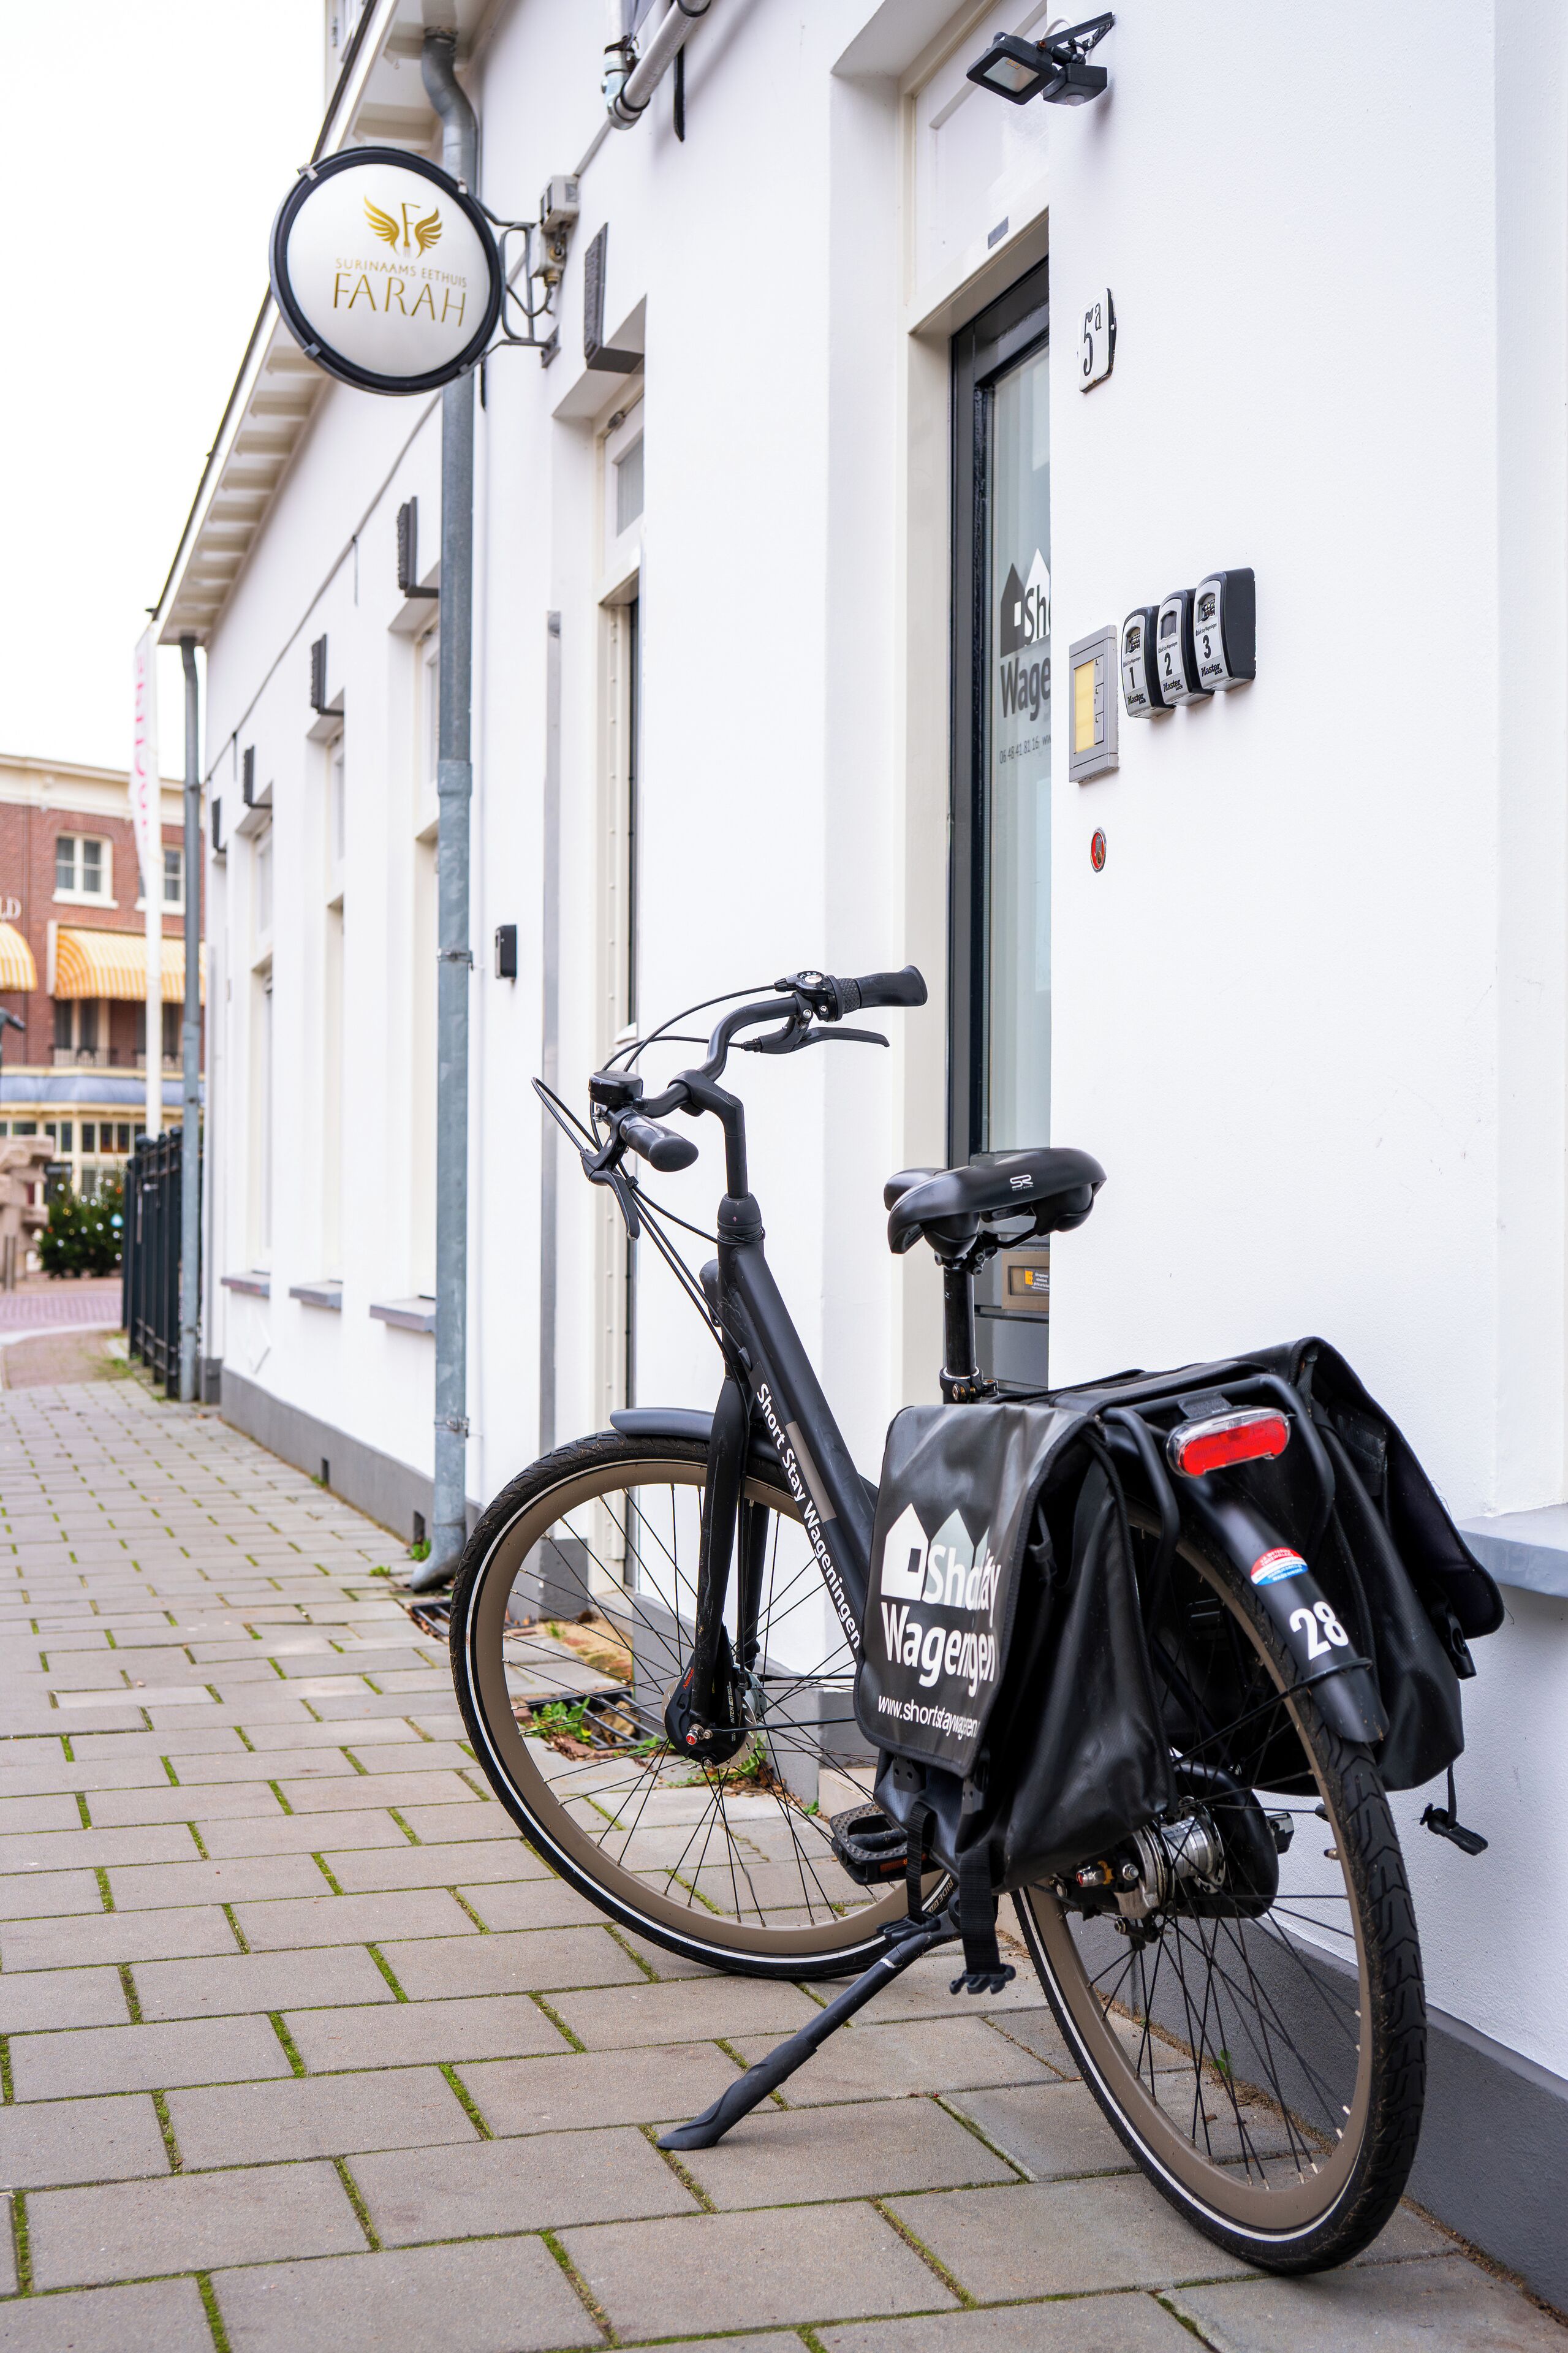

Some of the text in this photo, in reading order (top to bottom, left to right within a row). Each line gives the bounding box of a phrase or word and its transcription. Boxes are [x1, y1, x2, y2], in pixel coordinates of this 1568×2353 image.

[335, 258, 468, 288] SURINAAMS EETHUIS
[333, 273, 466, 327] FARAH
[1025, 585, 1050, 646] Sh
[1203, 634, 1211, 659] 3
[1164, 652, 1173, 676] 2
[1201, 663, 1221, 677] Master
[1129, 666, 1135, 689] 1
[1163, 679, 1181, 692] Master
[1127, 693, 1144, 705] Master
[1000, 749, 1007, 764] 06
[1007, 745, 1015, 760] 48
[1015, 742, 1022, 756] 41
[1024, 739, 1031, 754] 81
[1032, 735, 1039, 750] 16
[757, 1382, 862, 1650] Short Stay Wageningen
[1289, 1601, 1349, 1661] 28
[937, 1878, 953, 1903] RIDE
